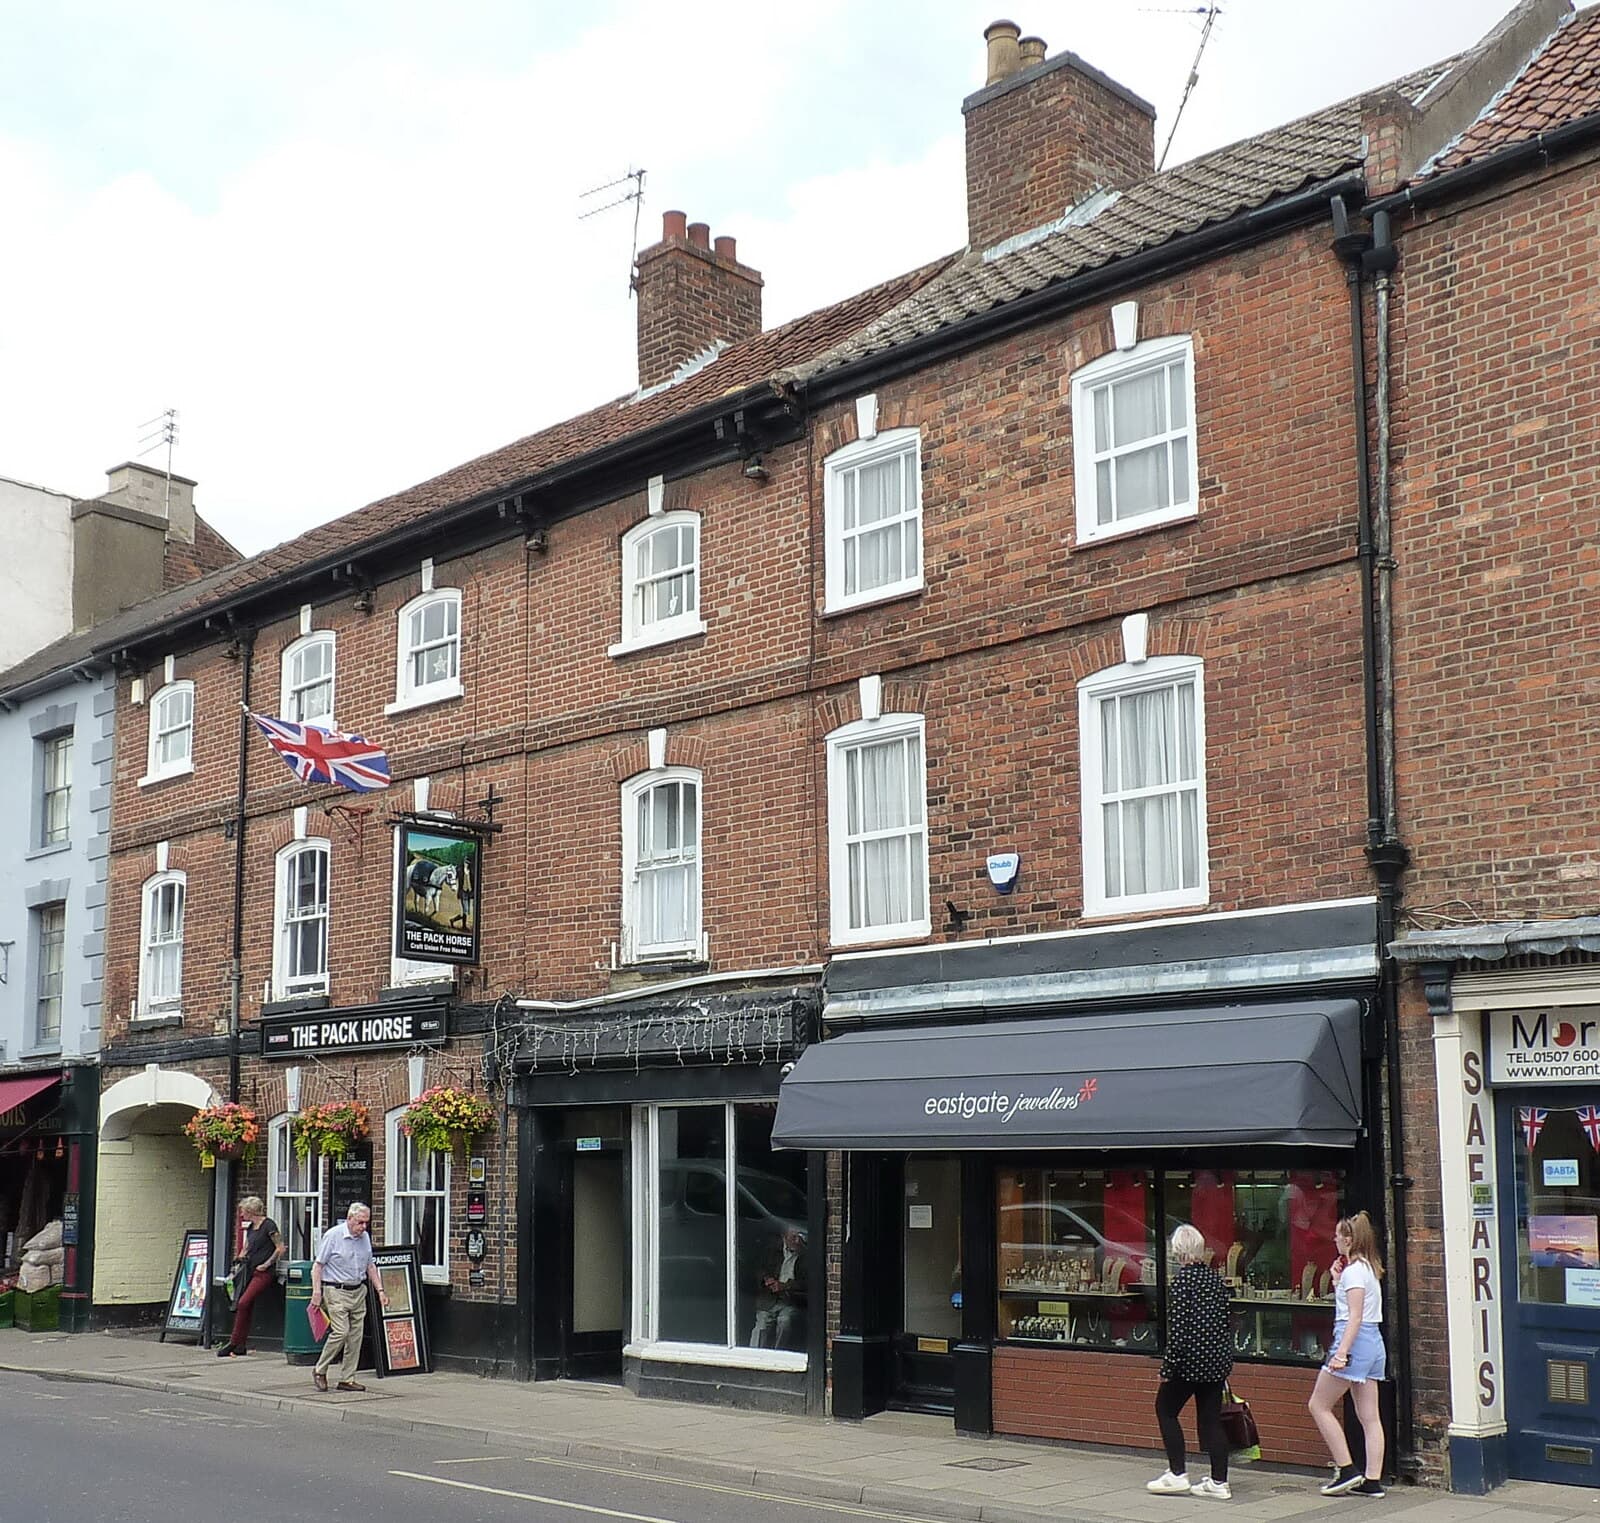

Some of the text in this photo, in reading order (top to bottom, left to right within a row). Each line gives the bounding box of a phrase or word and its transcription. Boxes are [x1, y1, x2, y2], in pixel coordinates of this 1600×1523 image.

[406, 930, 472, 946] THE PACK HORSE
[410, 942, 467, 954] Craft Union Free House
[291, 1016, 413, 1047] THE PACK HORSE
[1506, 1050, 1569, 1064] TEL.01507
[924, 1087, 1080, 1123] eastgate jewellers
[349, 1160, 367, 1169] HORSE
[1554, 1166, 1576, 1175] ABTA
[1464, 1051, 1496, 1408] SAFARIS
